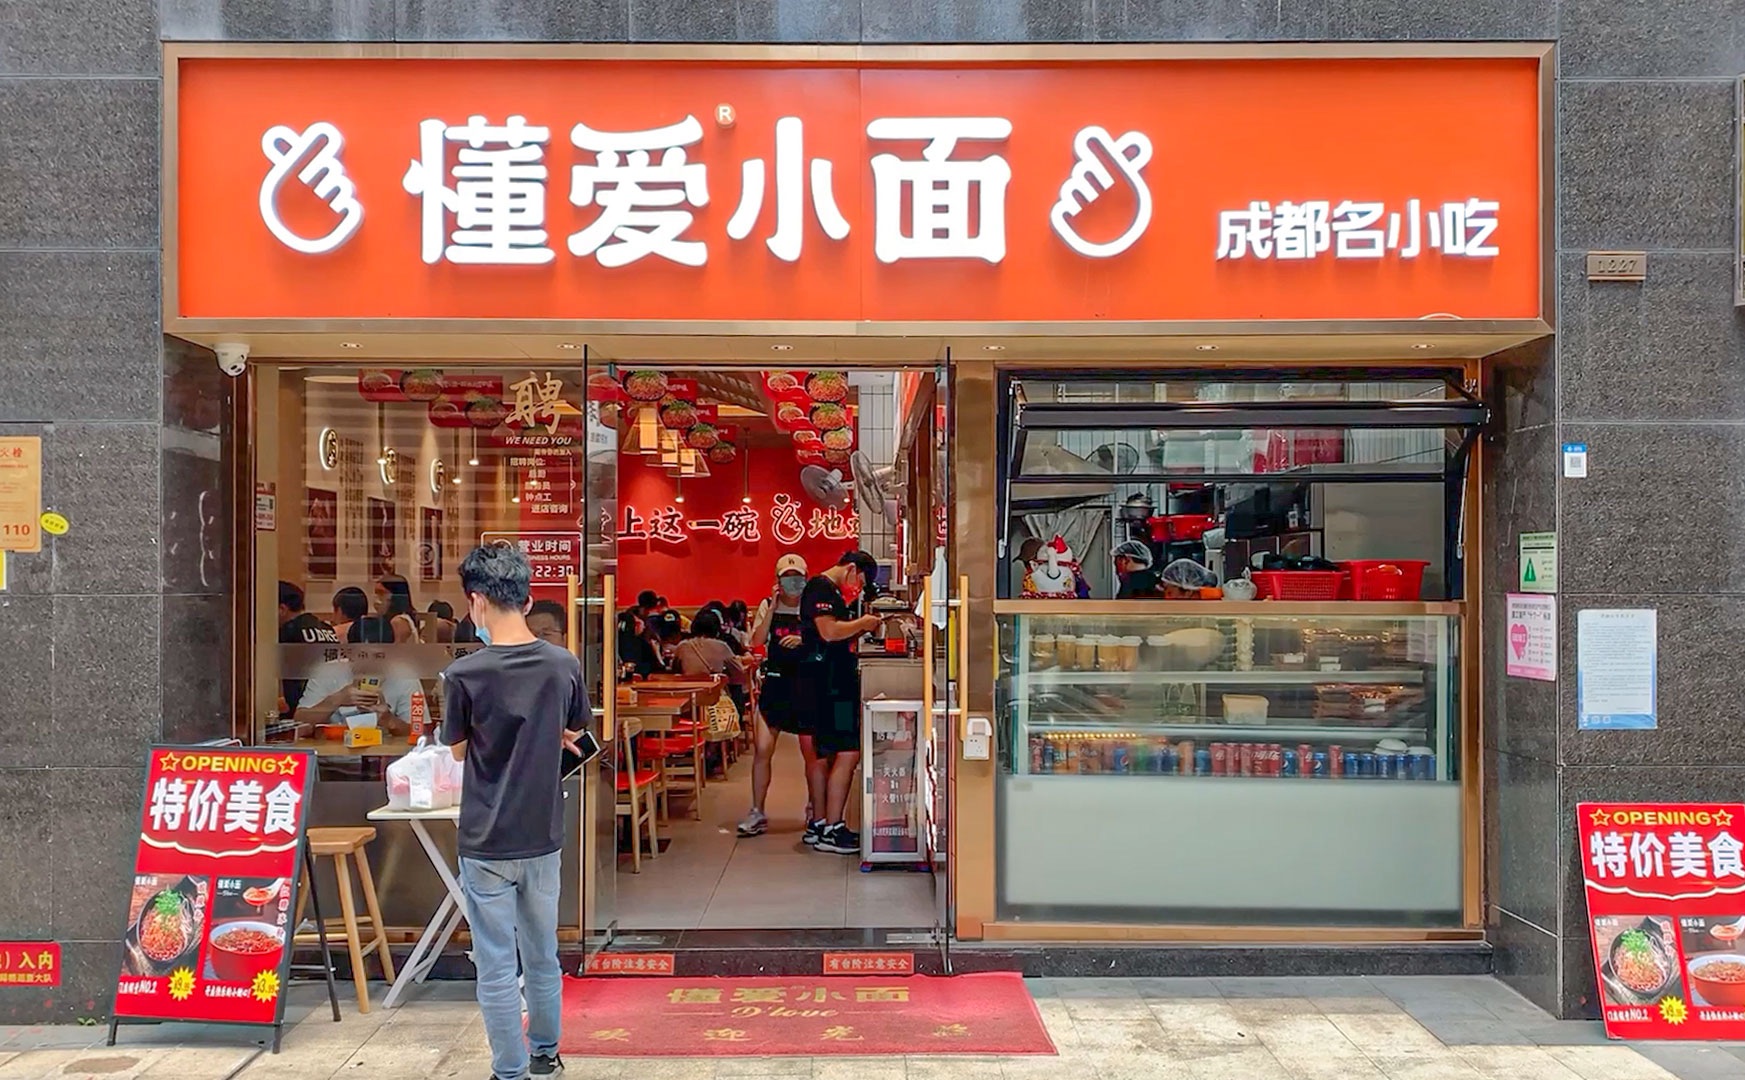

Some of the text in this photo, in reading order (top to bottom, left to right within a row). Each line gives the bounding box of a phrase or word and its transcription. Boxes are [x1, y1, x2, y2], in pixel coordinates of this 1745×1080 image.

[404, 115, 1012, 268] 懂爱小面
[1216, 198, 1501, 260] 成都名小吃
[1598, 259, 1637, 274] 1227
[505, 371, 563, 434] 聘
[505, 436, 572, 445] WE NEED YOU
[518, 540, 571, 553] 营业时间
[181, 755, 277, 774] OPENING
[149, 777, 302, 836] 特价美食
[1612, 811, 1712, 826] OPENING
[1589, 831, 1745, 879] 特价美食
[0, 951, 54, 970] ）入内
[590, 958, 669, 971] 有台阶注意安全
[828, 957, 909, 971] 有台阶注意安全
[667, 985, 910, 1004] 懂爱小面
[730, 1006, 840, 1018] D'love
